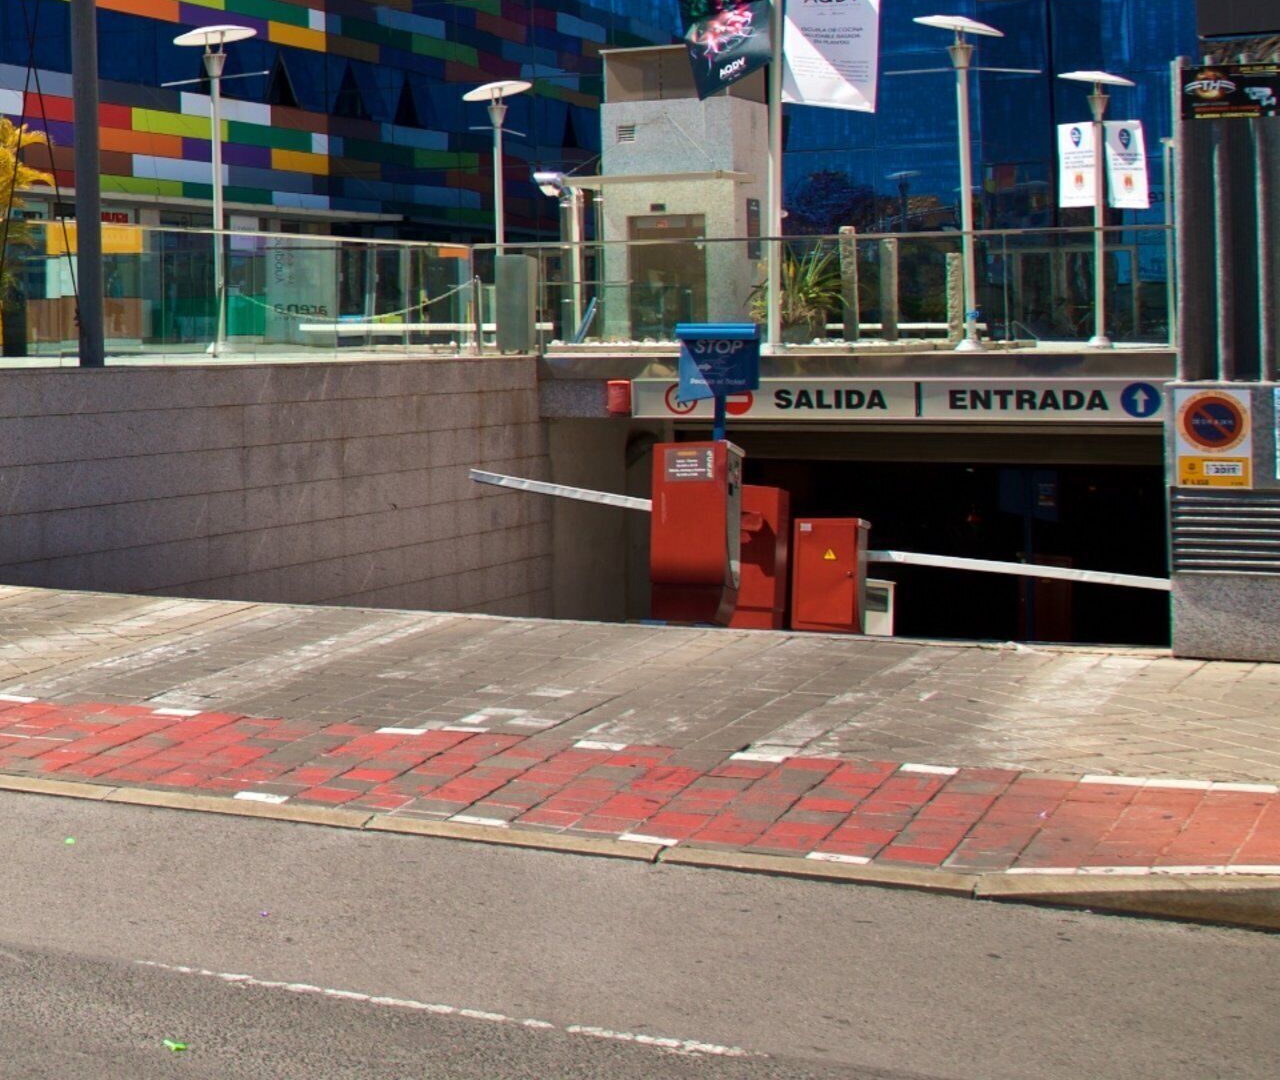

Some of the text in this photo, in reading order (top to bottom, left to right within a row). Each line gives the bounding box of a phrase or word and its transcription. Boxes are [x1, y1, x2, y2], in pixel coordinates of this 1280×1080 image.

[719, 57, 746, 78] AQDV
[694, 339, 744, 354] STOP
[774, 388, 888, 410] SALIDA
[948, 388, 1109, 411] ENTRADA
